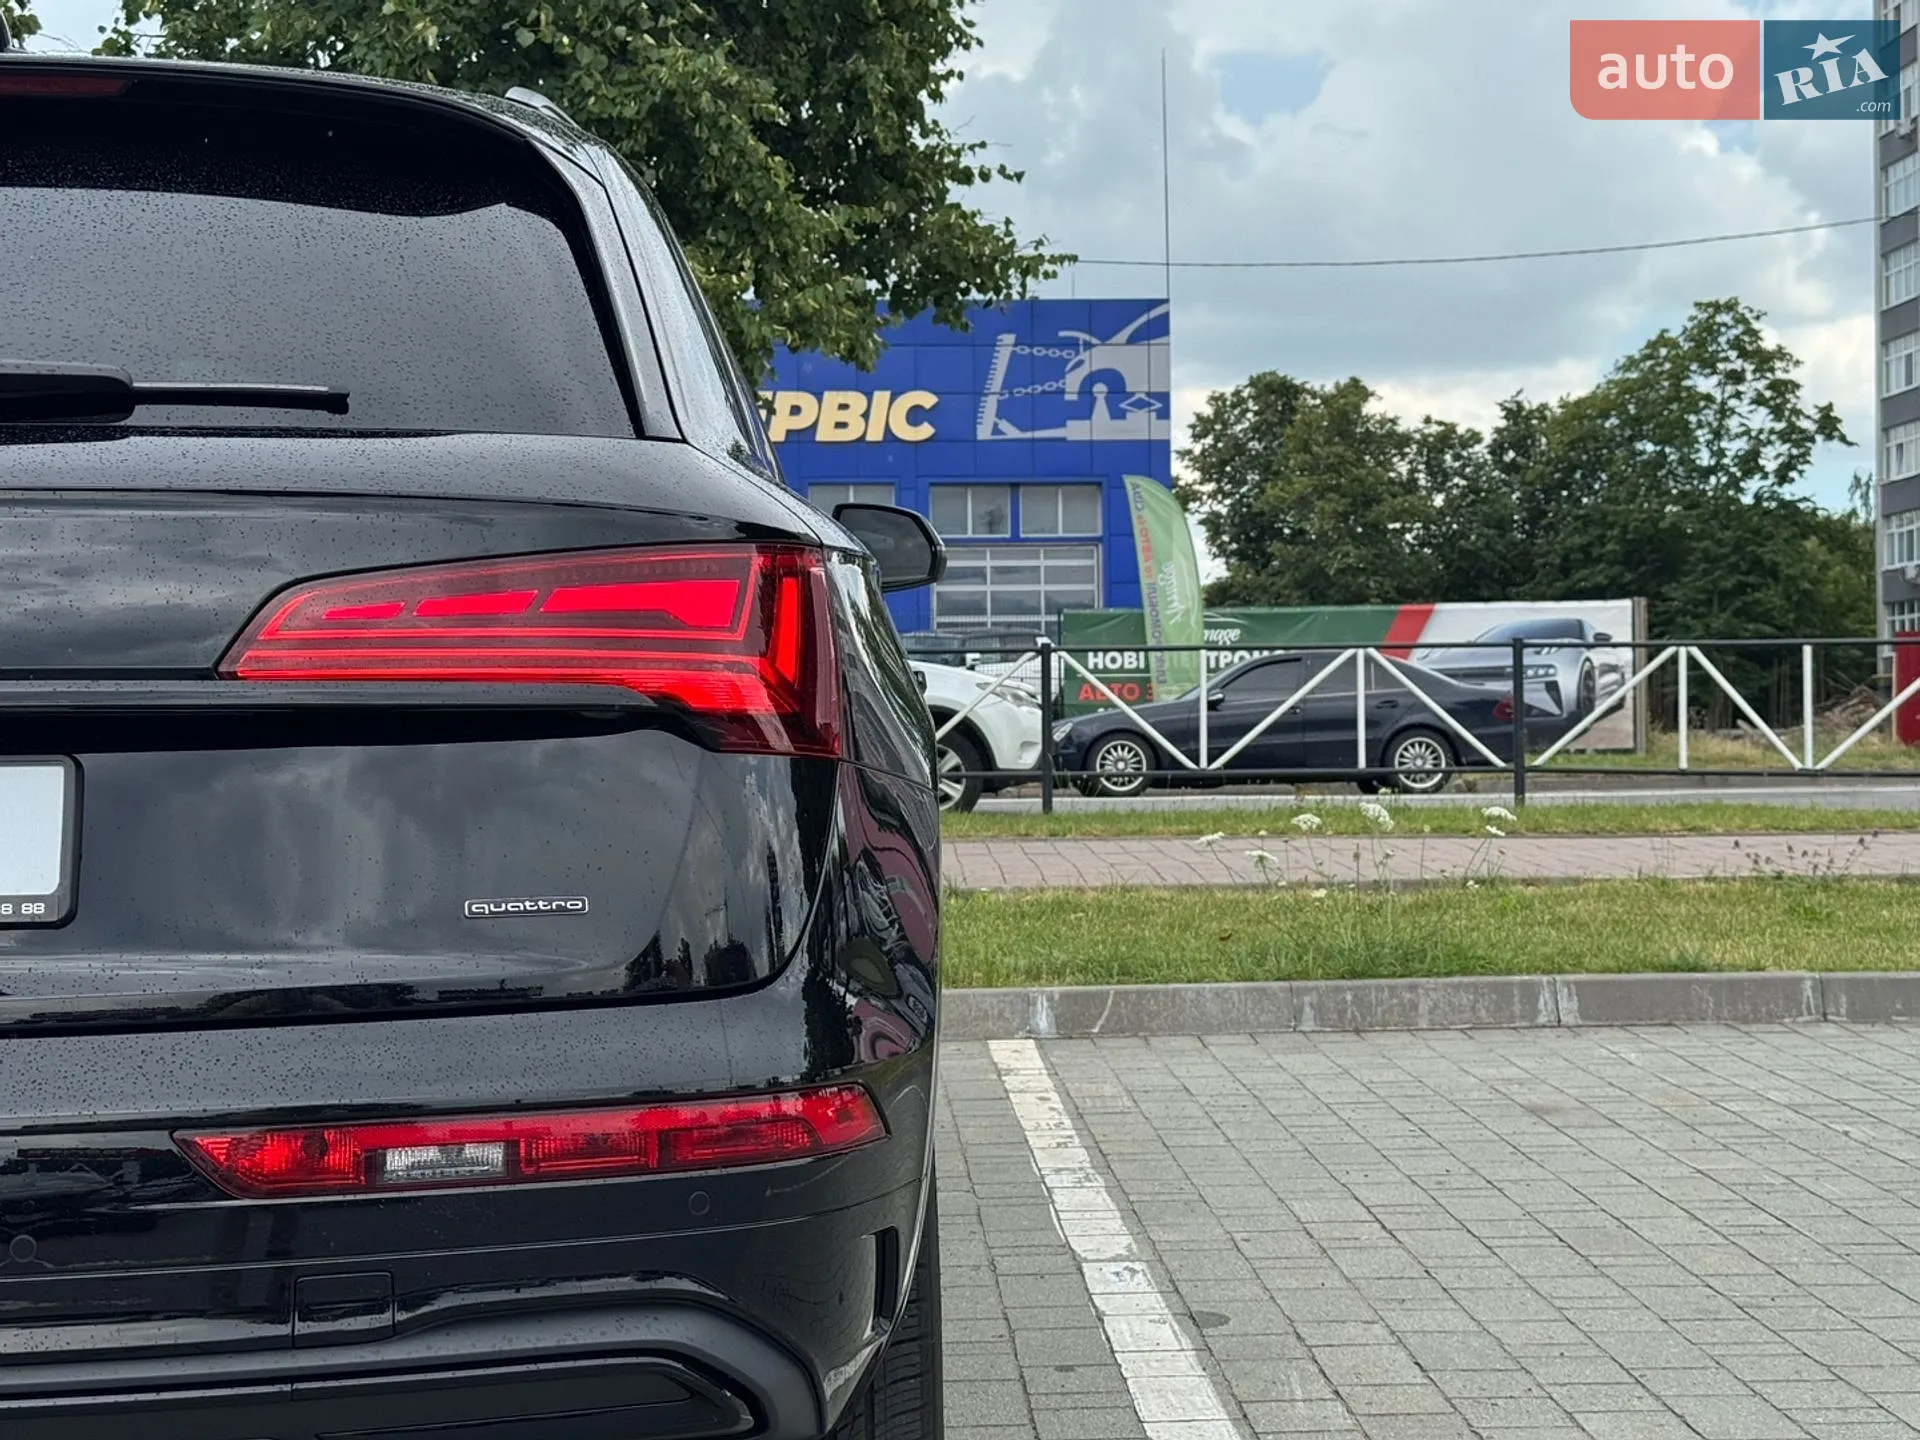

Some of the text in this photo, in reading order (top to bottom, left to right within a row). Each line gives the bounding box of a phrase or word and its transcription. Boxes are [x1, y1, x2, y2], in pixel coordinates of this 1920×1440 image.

[1088, 651, 1145, 670] НОВІ
[21, 902, 46, 915] 88
[471, 900, 583, 914] quattro
